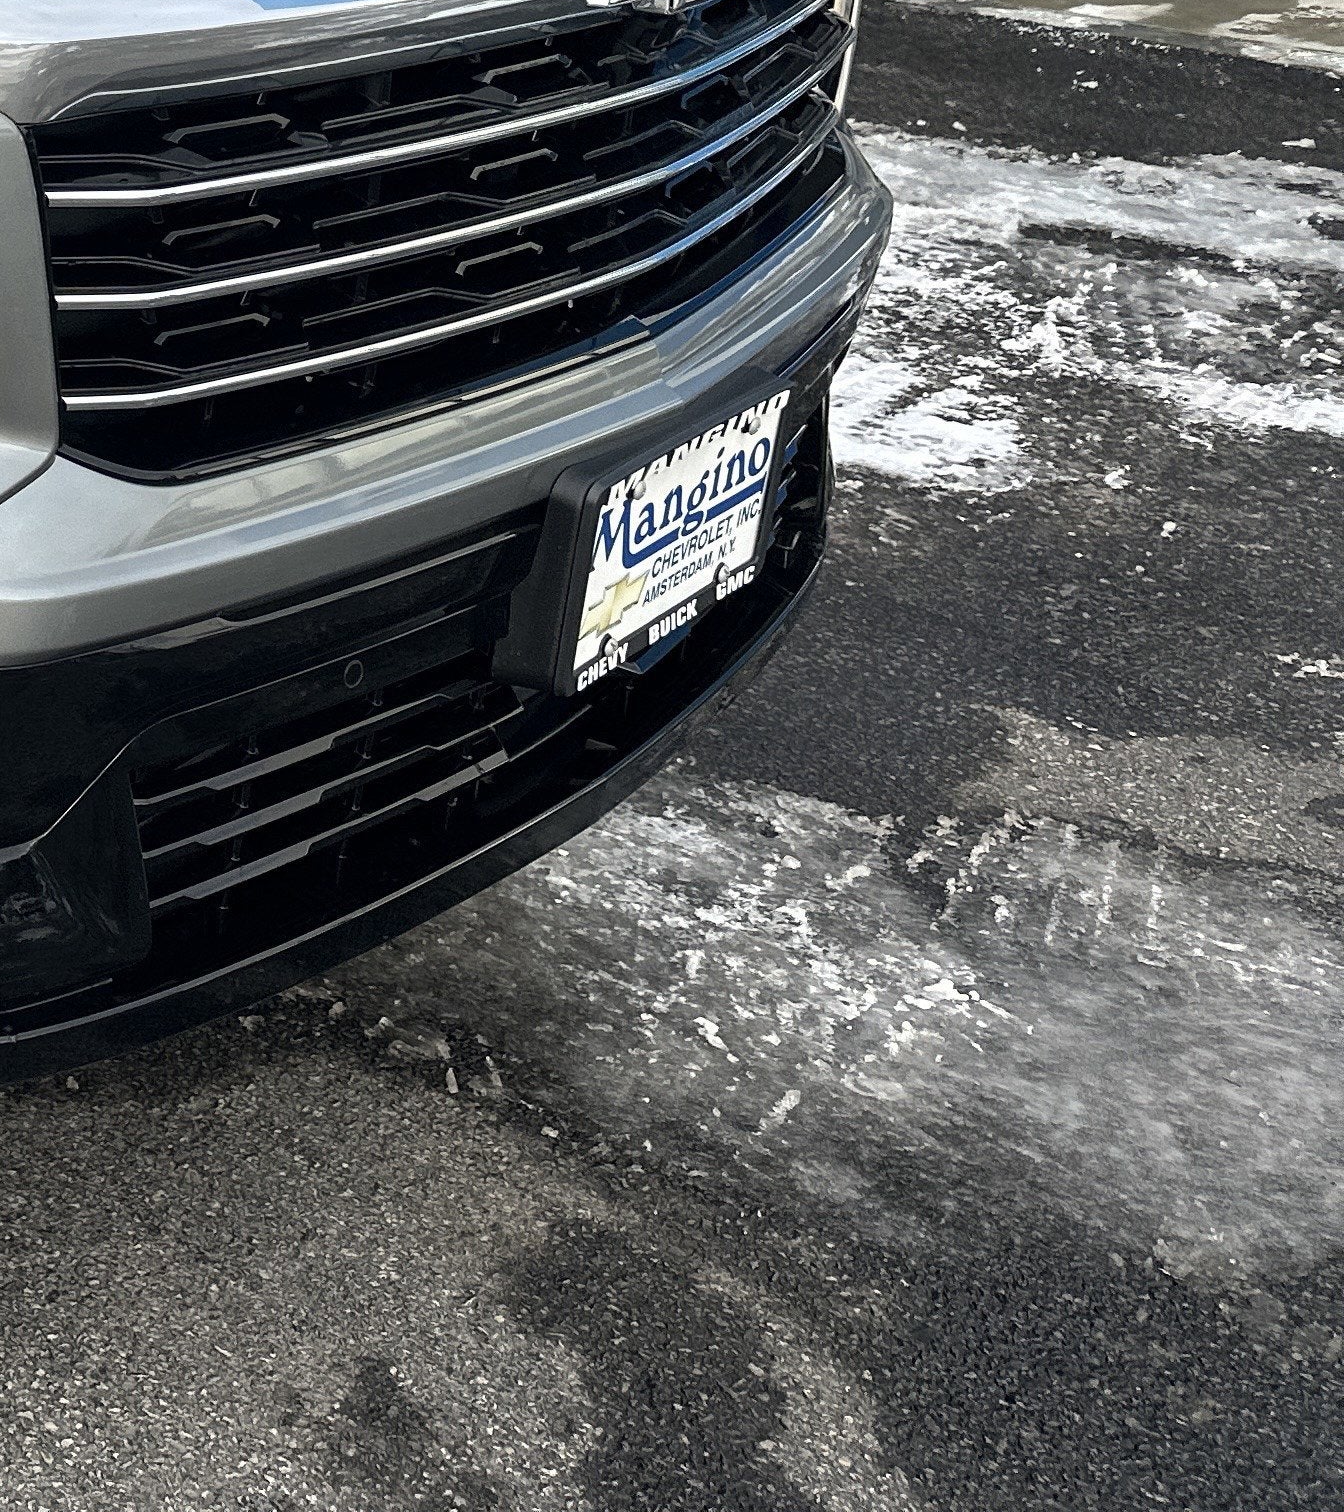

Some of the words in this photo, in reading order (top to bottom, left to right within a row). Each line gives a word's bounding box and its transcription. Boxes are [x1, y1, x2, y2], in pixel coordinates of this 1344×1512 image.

[591, 437, 770, 569] Mangino
[737, 498, 761, 528] INC.
[577, 642, 629, 691] CHEVY
[648, 598, 698, 645] BUICK
[716, 565, 756, 600] GMC
